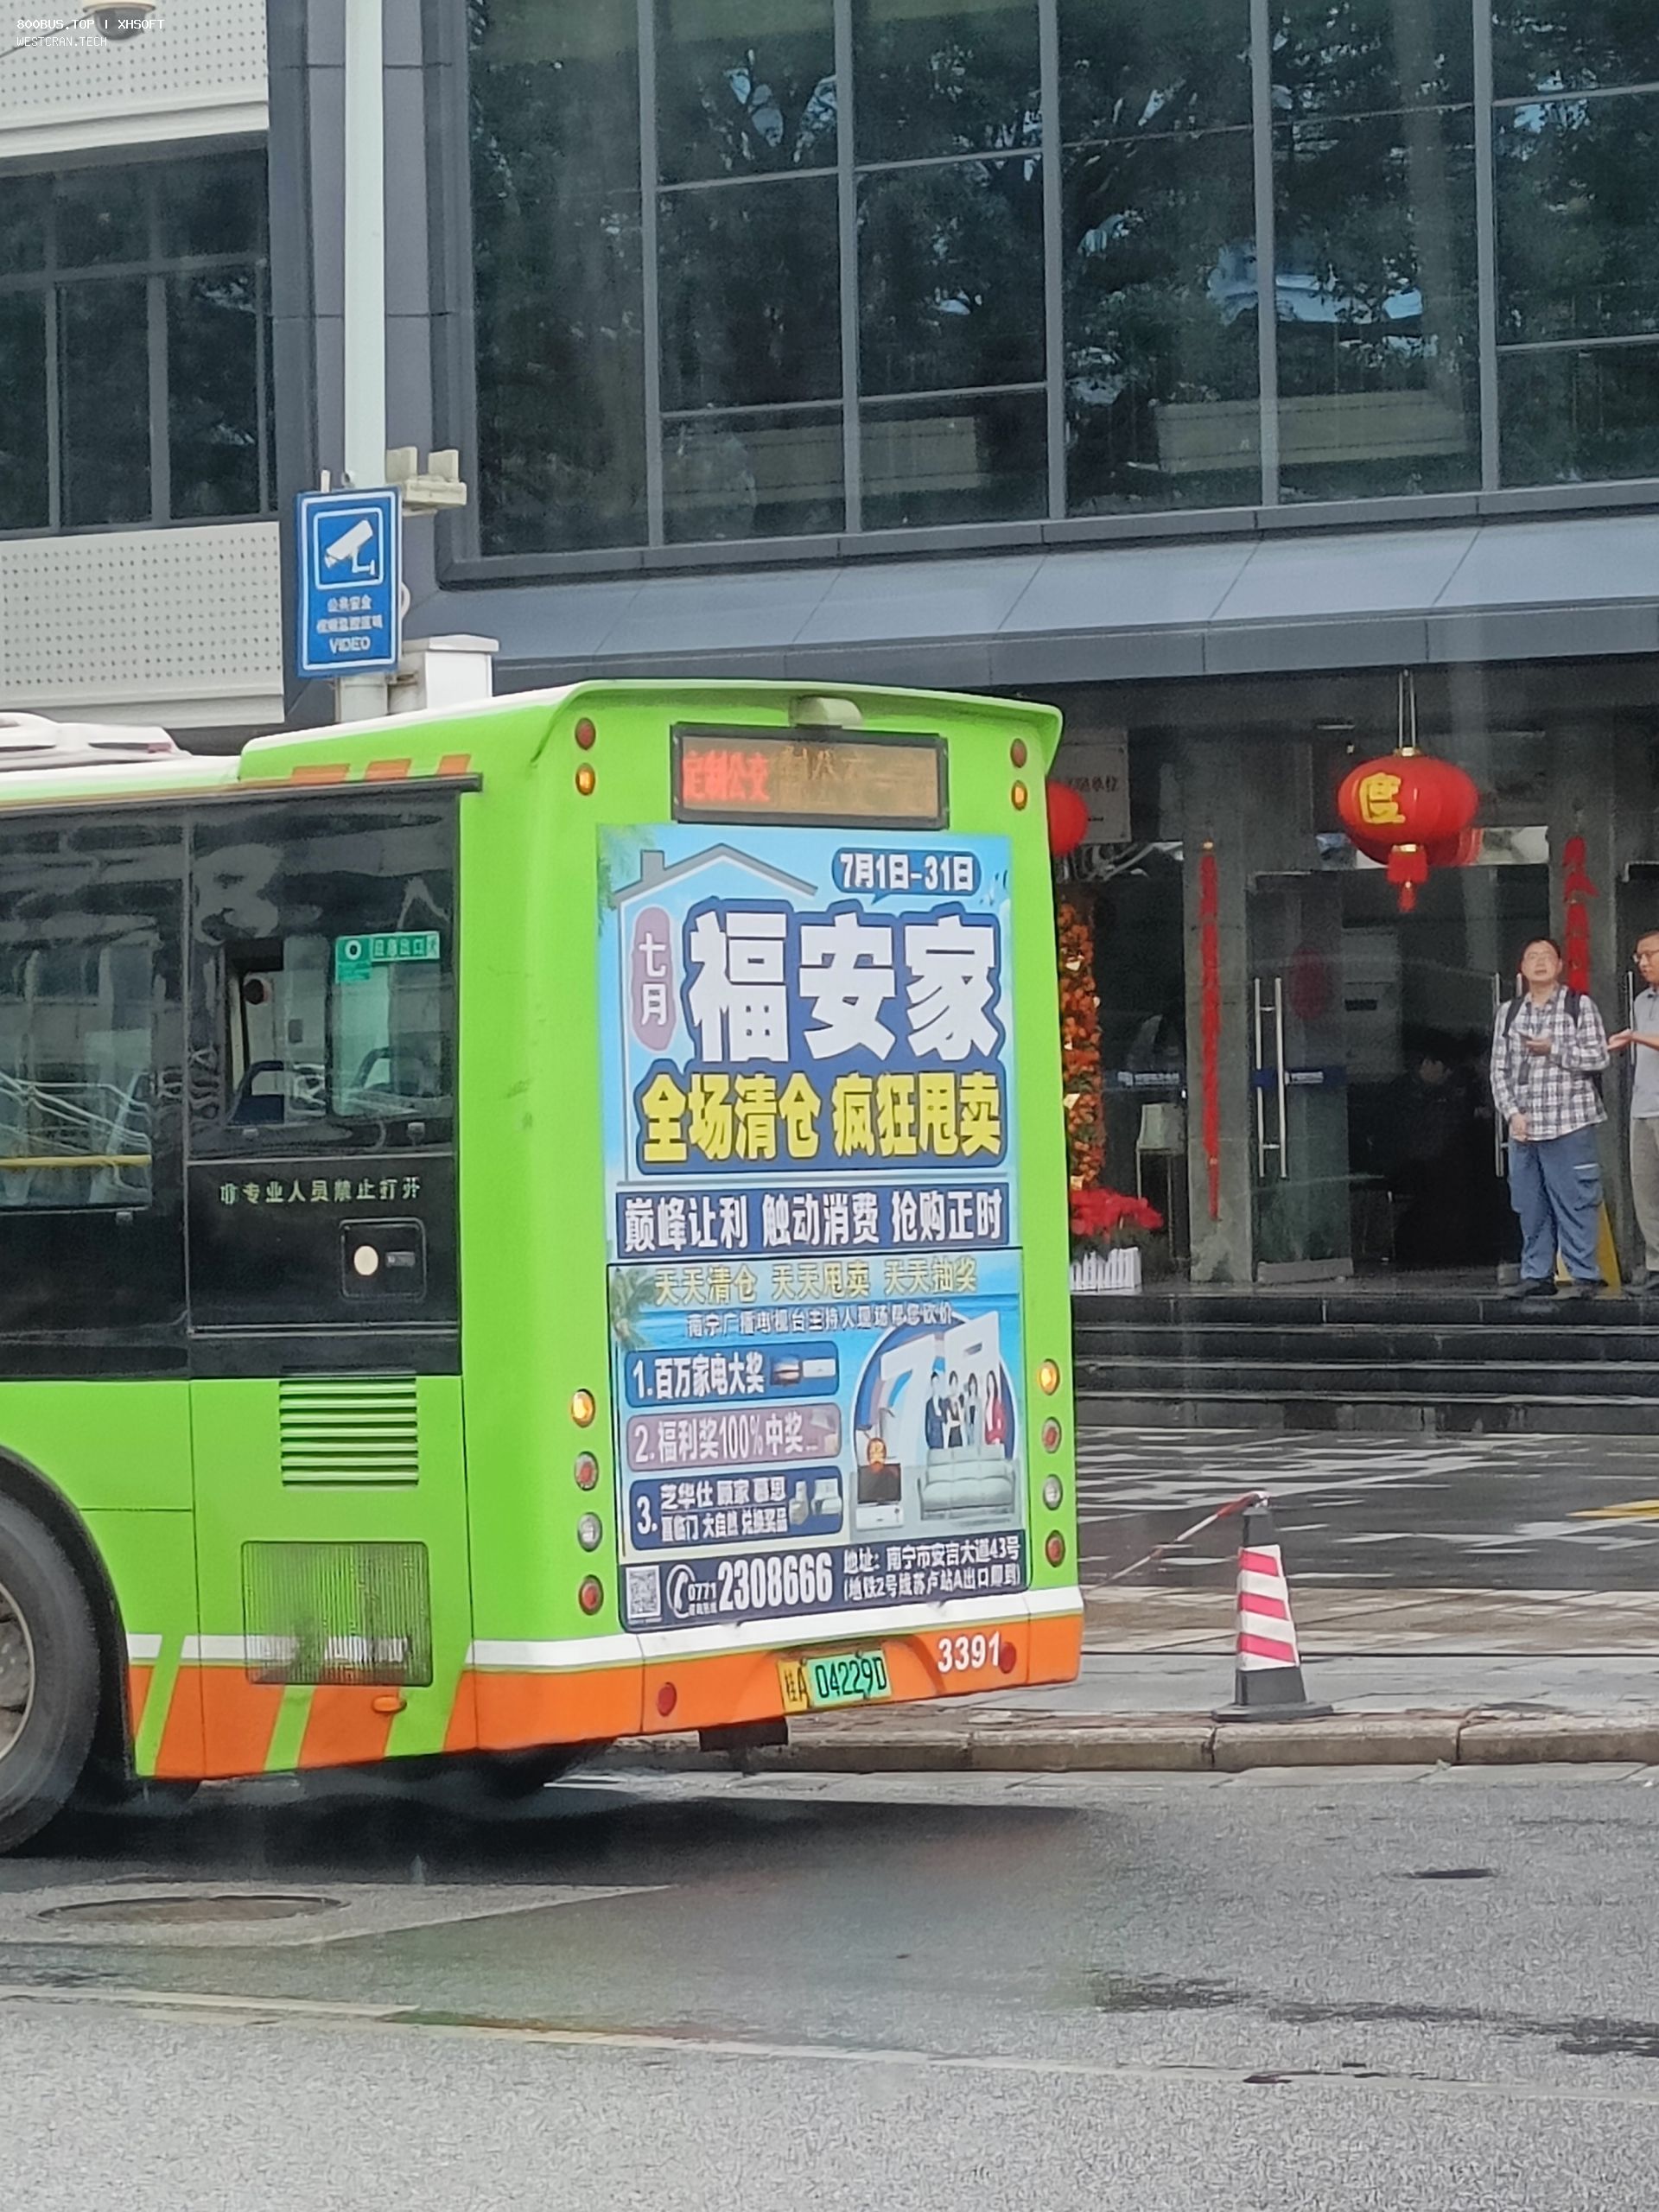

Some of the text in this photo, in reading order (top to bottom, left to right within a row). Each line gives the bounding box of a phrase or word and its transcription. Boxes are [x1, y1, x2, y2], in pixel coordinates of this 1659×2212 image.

[329, 636, 371, 654] VIDEO
[840, 853, 974, 892] 7月1日-31日
[639, 932, 667, 1027] 七月
[689, 912, 999, 1063] 福安家
[641, 1071, 1001, 1162] 全场清仓 疯狂甩卖
[219, 1176, 421, 1205] 非专业人员禁止打开
[625, 1188, 1002, 1253] 巅峰让利 触动消费 抢购正时
[654, 1258, 977, 1306] 天天清仓 天天甩卖 天天抽奖
[633, 1351, 765, 1400] 1.百万家电大奖
[637, 1496, 658, 1535] 3.
[660, 1480, 714, 1510] 芝华仕
[688, 1552, 833, 1611] 0771 2308666
[938, 1630, 1001, 1673] 3391
